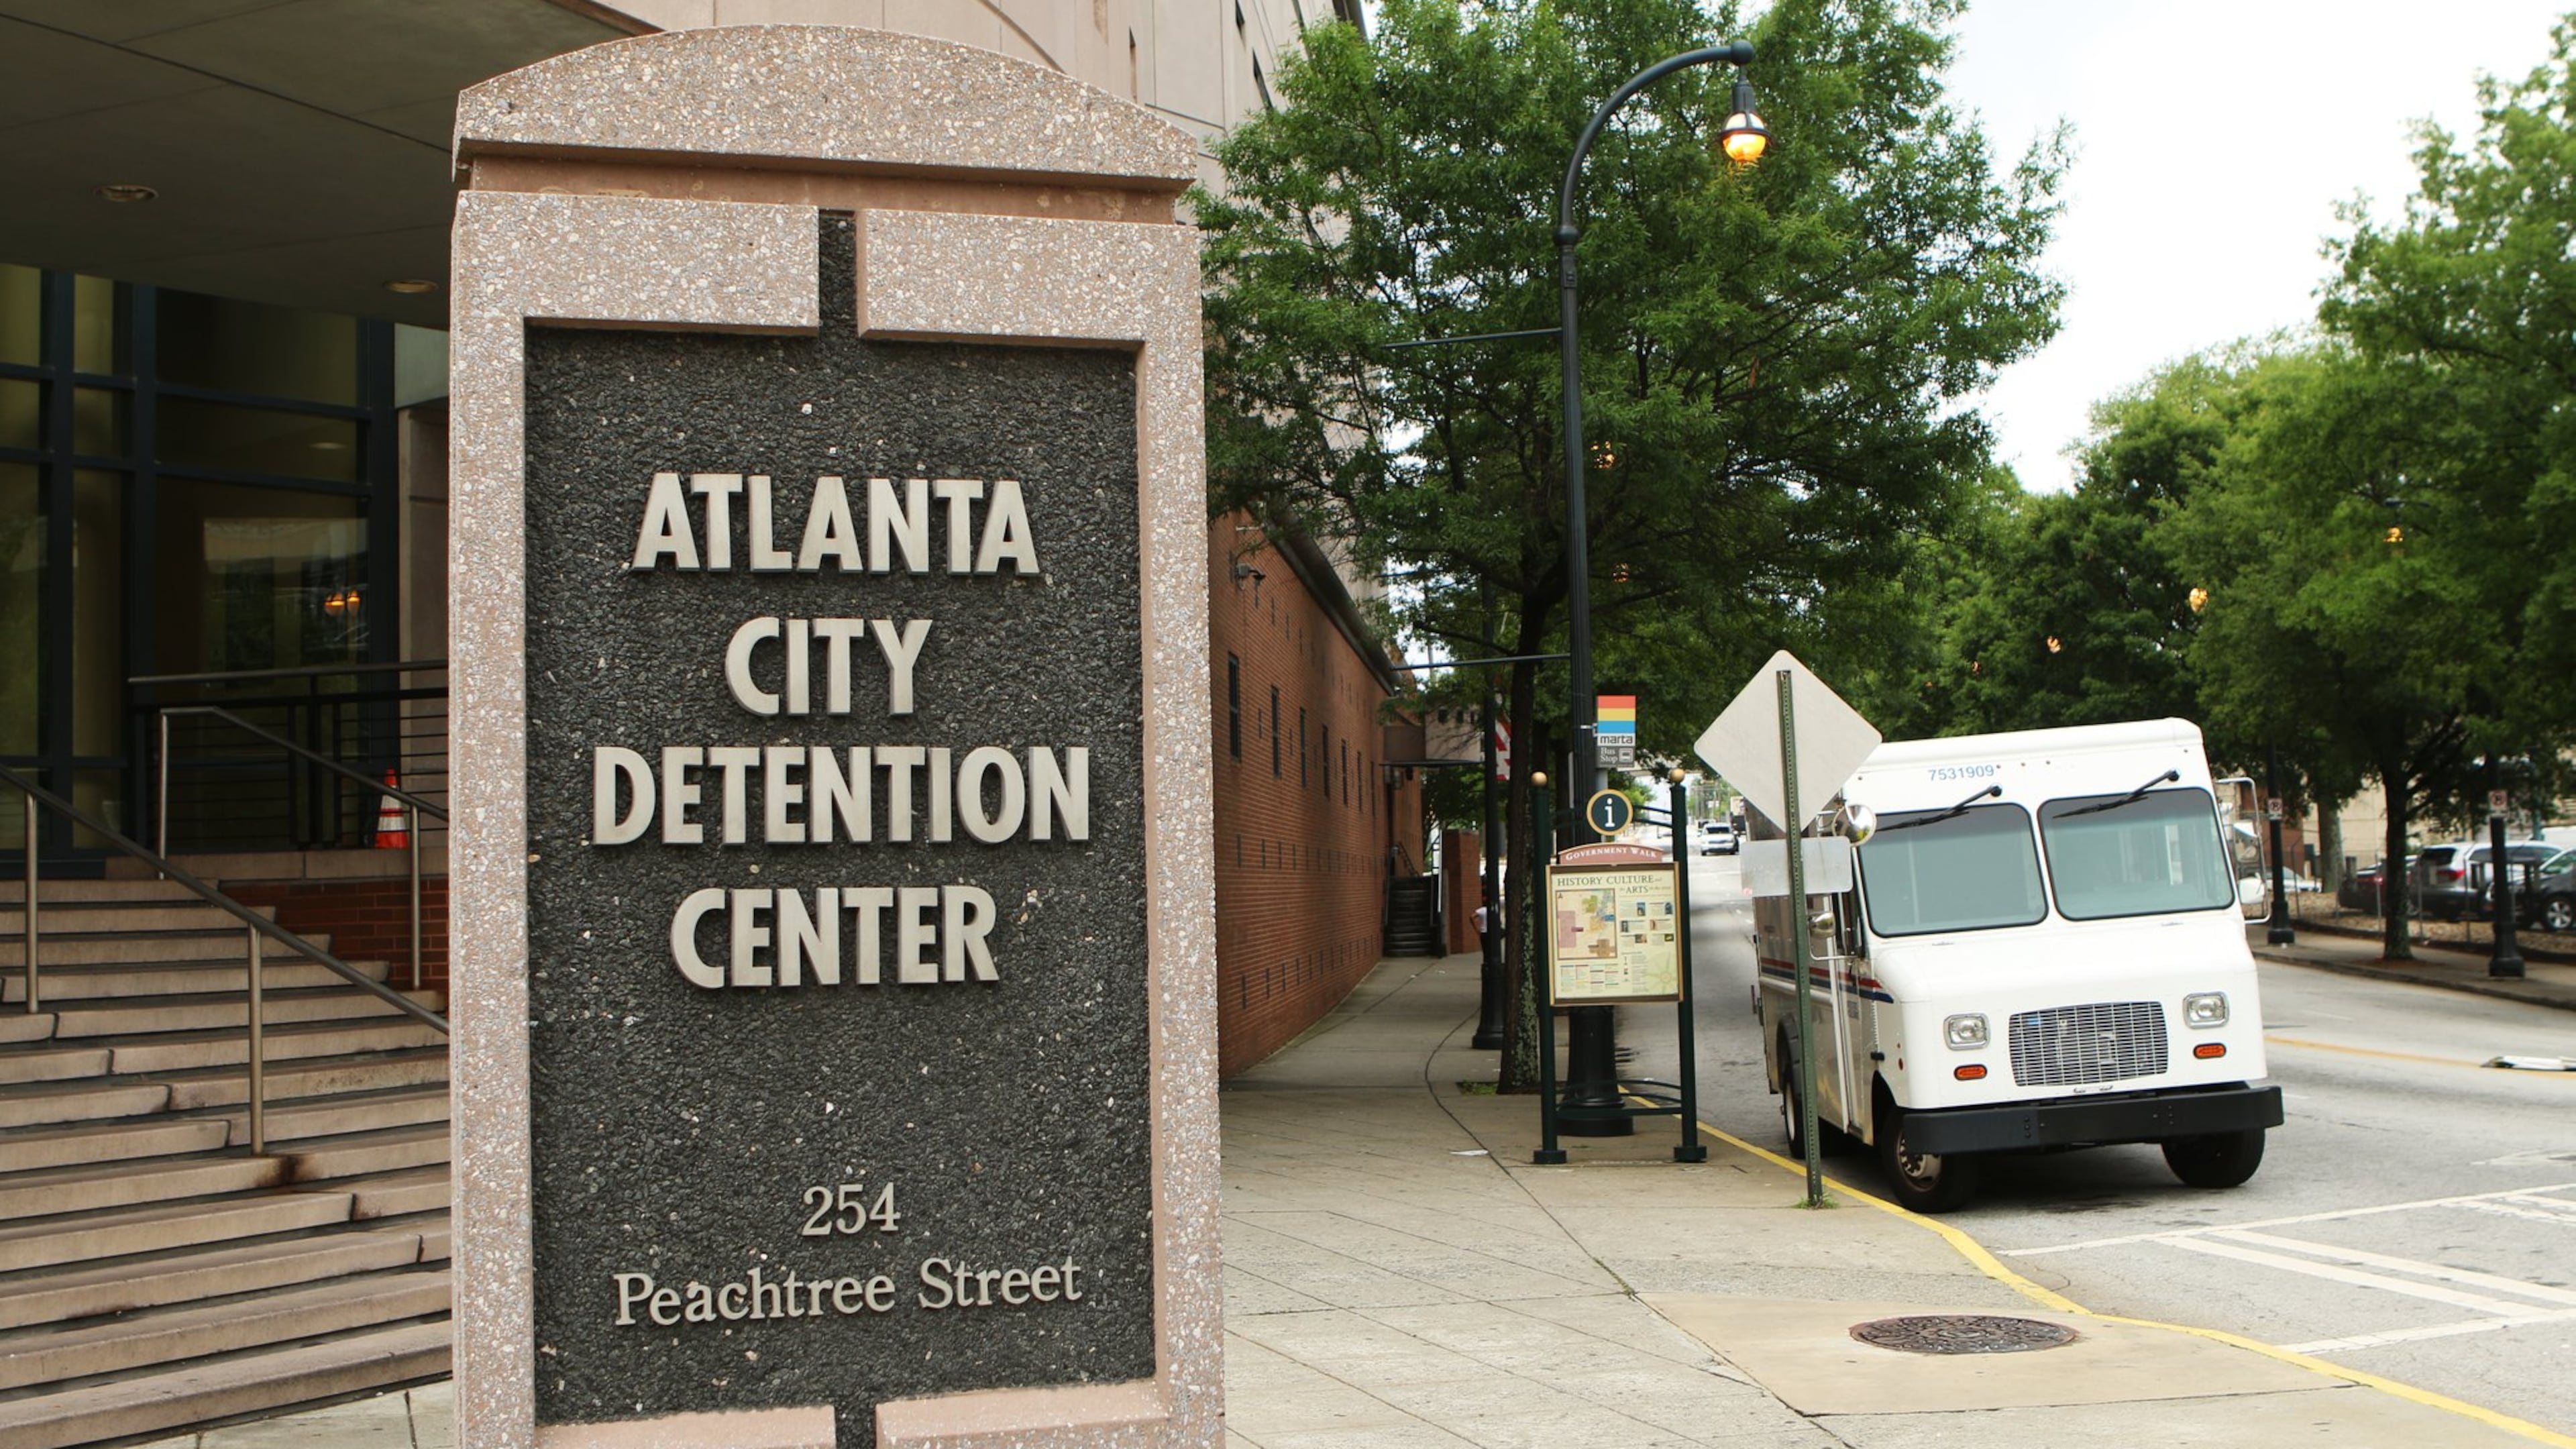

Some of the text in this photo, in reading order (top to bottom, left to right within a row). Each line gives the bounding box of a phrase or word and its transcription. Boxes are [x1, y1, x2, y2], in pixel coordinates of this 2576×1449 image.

[632, 472, 1040, 575] ATLANTA
[724, 617, 933, 716] CITY
[1600, 735, 1633, 744] marta
[1600, 755, 1618, 764] Stop
[1601, 747, 1616, 755] Bus
[1927, 764, 1994, 781] 7531909
[593, 746, 1090, 845] DETENTION
[1565, 847, 1656, 861] GOVERNMENT WALK
[1557, 877, 1603, 886] HISTORY
[1606, 875, 1654, 885] CULTURE
[1625, 885, 1649, 894] ARTS
[669, 886, 1000, 989] CENTER
[801, 1182, 900, 1236] 254
[613, 1256, 1083, 1326] Peachtree Street
